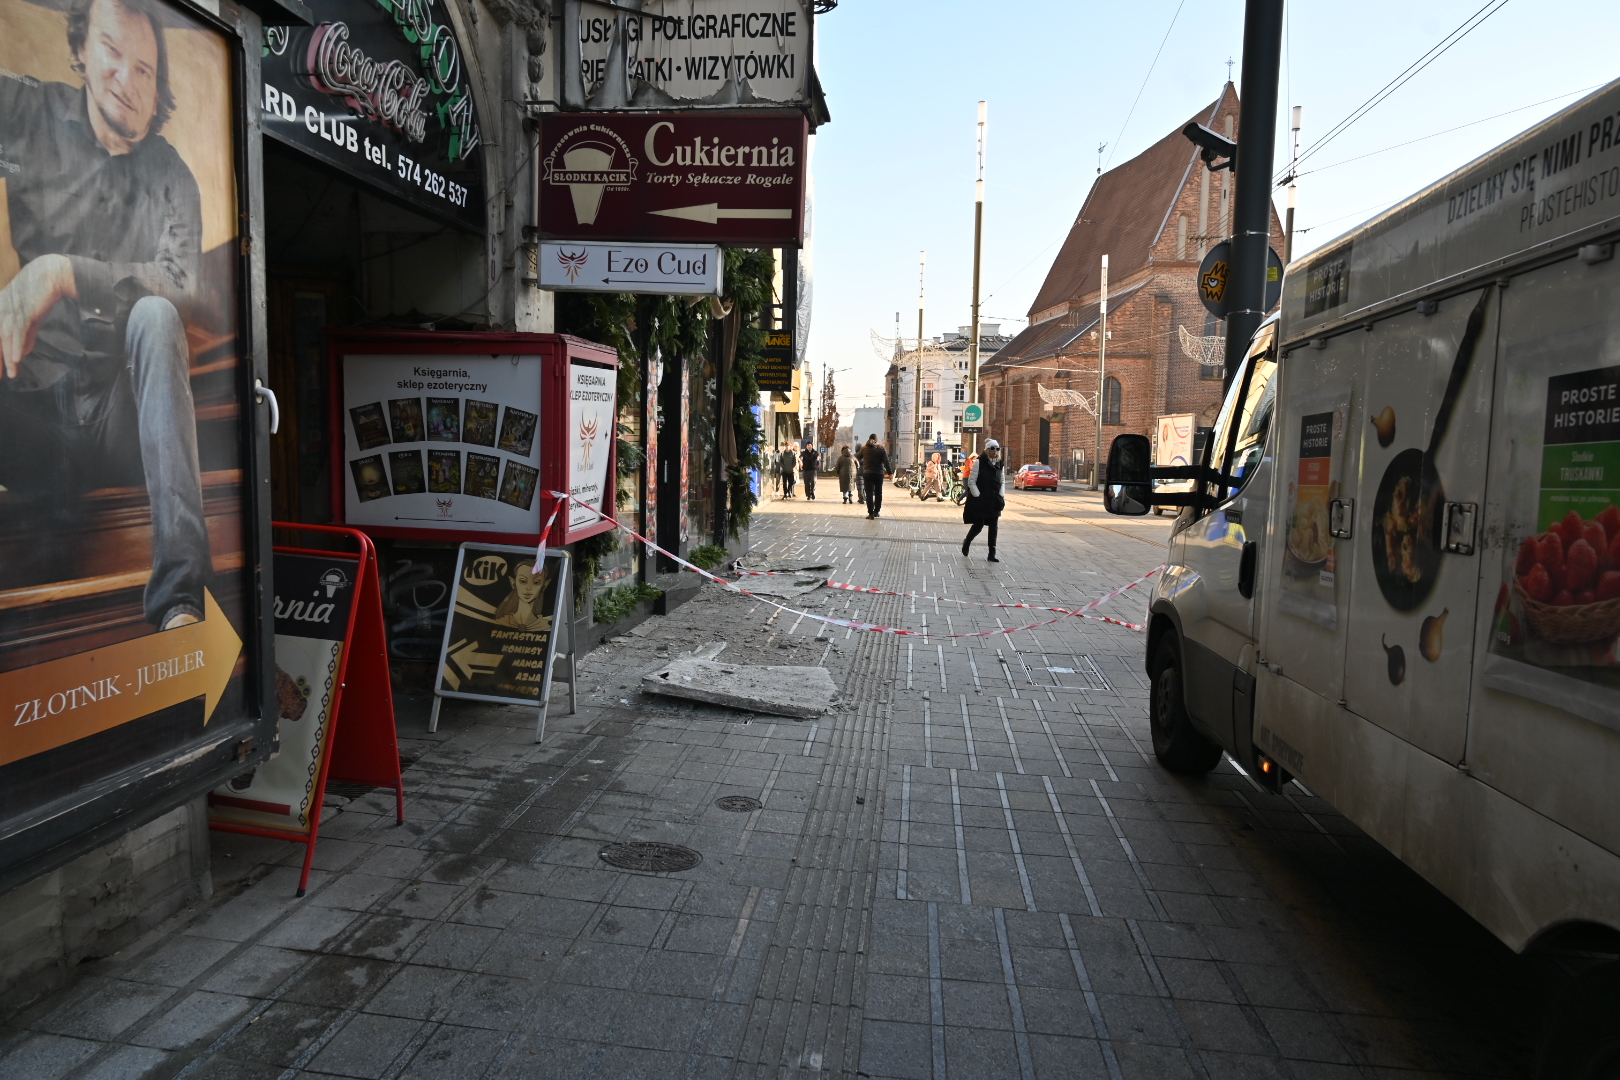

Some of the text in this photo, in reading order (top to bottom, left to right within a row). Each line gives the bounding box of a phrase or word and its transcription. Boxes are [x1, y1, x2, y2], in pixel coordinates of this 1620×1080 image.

[580, 12, 796, 43] USŁGI POLIGRAFICZNE
[684, 51, 795, 81] WIZYTÓWKI
[308, 21, 431, 143] Coca-Cola
[261, 83, 467, 207] RD CLUB tel. 574 262 537
[550, 123, 632, 159] Pracownia Cukiernicza
[644, 121, 795, 167] Cukiernia
[553, 173, 628, 184] SŁODKI KĄCIK
[647, 172, 793, 188] Torty Sękacze Rogale
[1447, 168, 1508, 225] DZIELMY
[1511, 153, 1537, 194] SIĘ
[1541, 131, 1583, 181] NIMI
[607, 250, 706, 276] Ezo Cud
[1313, 259, 1343, 284] PROSTE
[1310, 277, 1344, 303] HISTORIE
[413, 366, 471, 379] Księgarnia,
[577, 374, 606, 388] KSIĘGARNIA
[397, 379, 488, 393] sklep ezoteryczny
[582, 391, 613, 402] EZOTERYCZNY
[1561, 384, 1617, 406] PROSTE
[1554, 406, 1620, 428] HISTORIE
[1306, 423, 1327, 434] PROSTE
[1303, 437, 1328, 448] HISTORIE
[1560, 466, 1604, 481] TRUSKAWKI
[466, 560, 507, 581] KiK
[490, 630, 547, 643] FANTASTYKA
[501, 644, 543, 656] KOMIKSY
[511, 659, 543, 669] MANGA
[14, 675, 122, 726] ZŁOTNIK
[135, 650, 206, 695] JUBILER
[515, 673, 541, 683] AZJA
